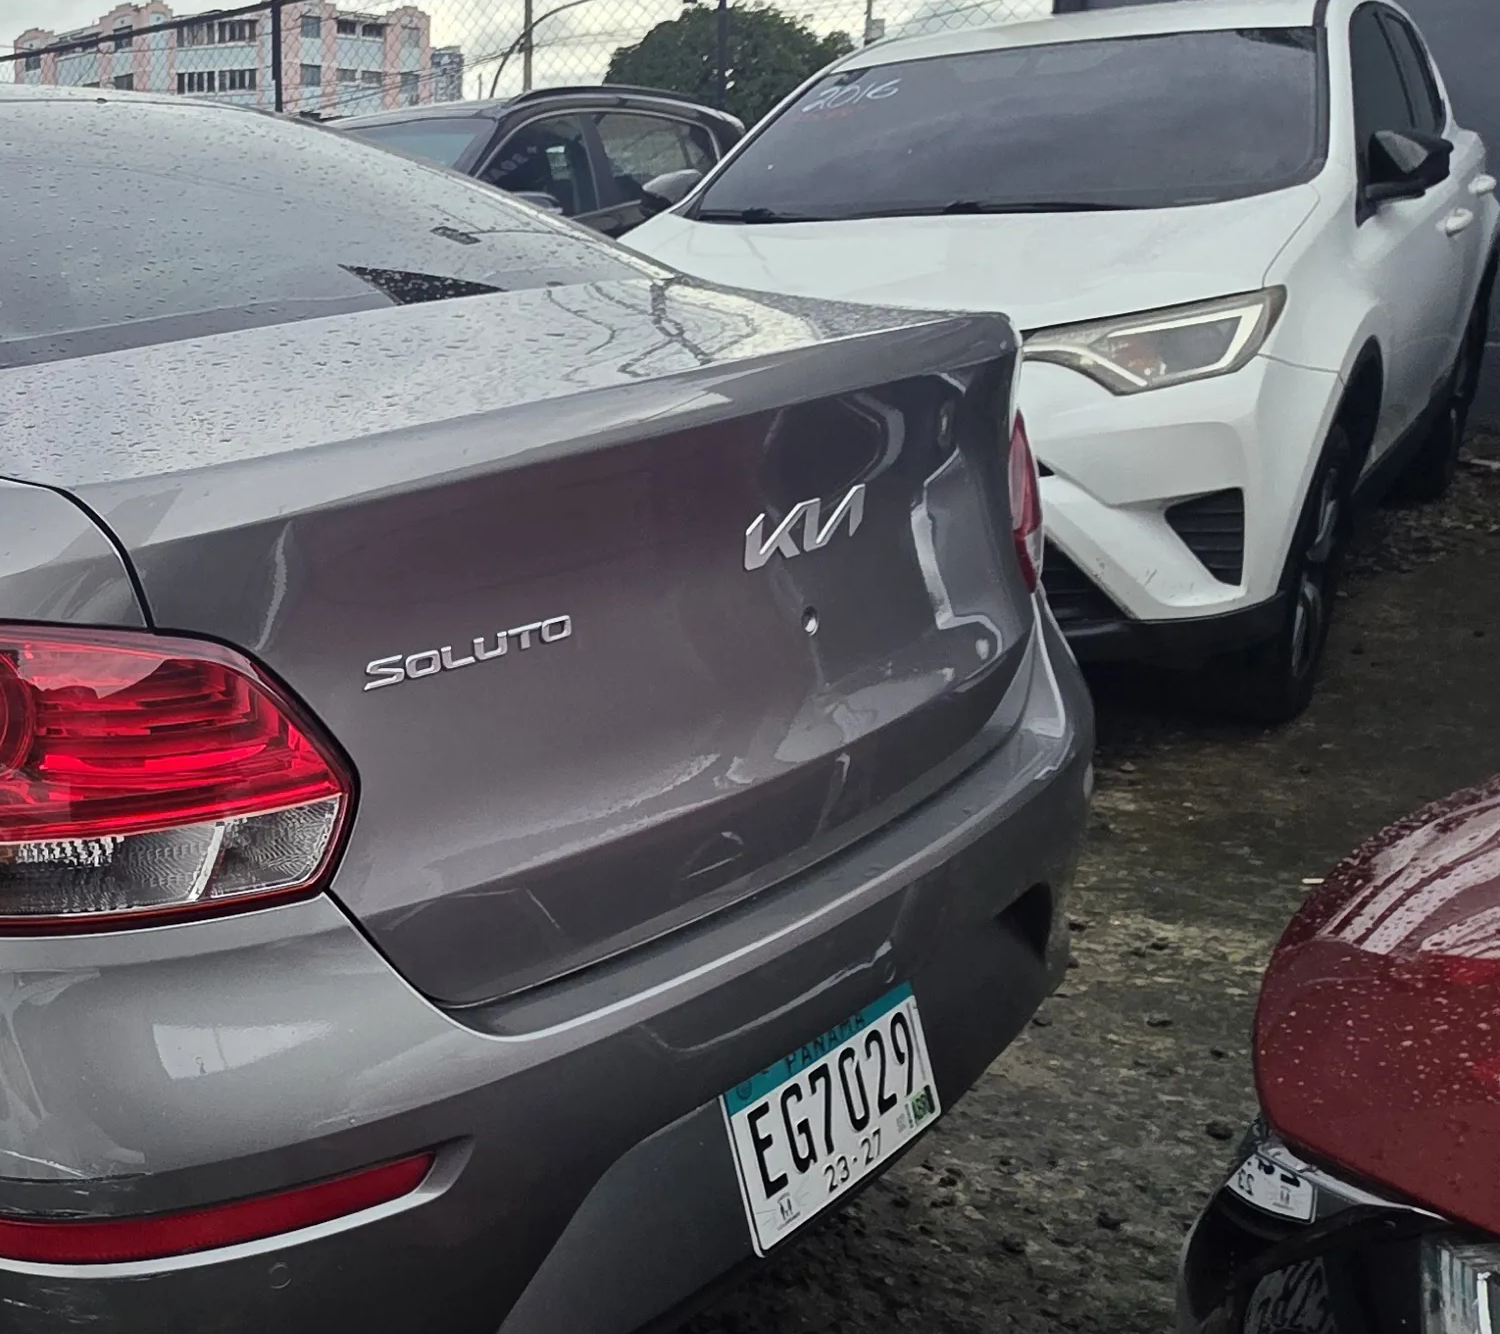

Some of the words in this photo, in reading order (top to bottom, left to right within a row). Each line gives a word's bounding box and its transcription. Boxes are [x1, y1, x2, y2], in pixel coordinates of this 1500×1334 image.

[802, 78, 901, 113] 2016
[744, 483, 866, 571] KIA
[363, 614, 573, 691] SOLUTO
[746, 1012, 914, 1200] EG7029
